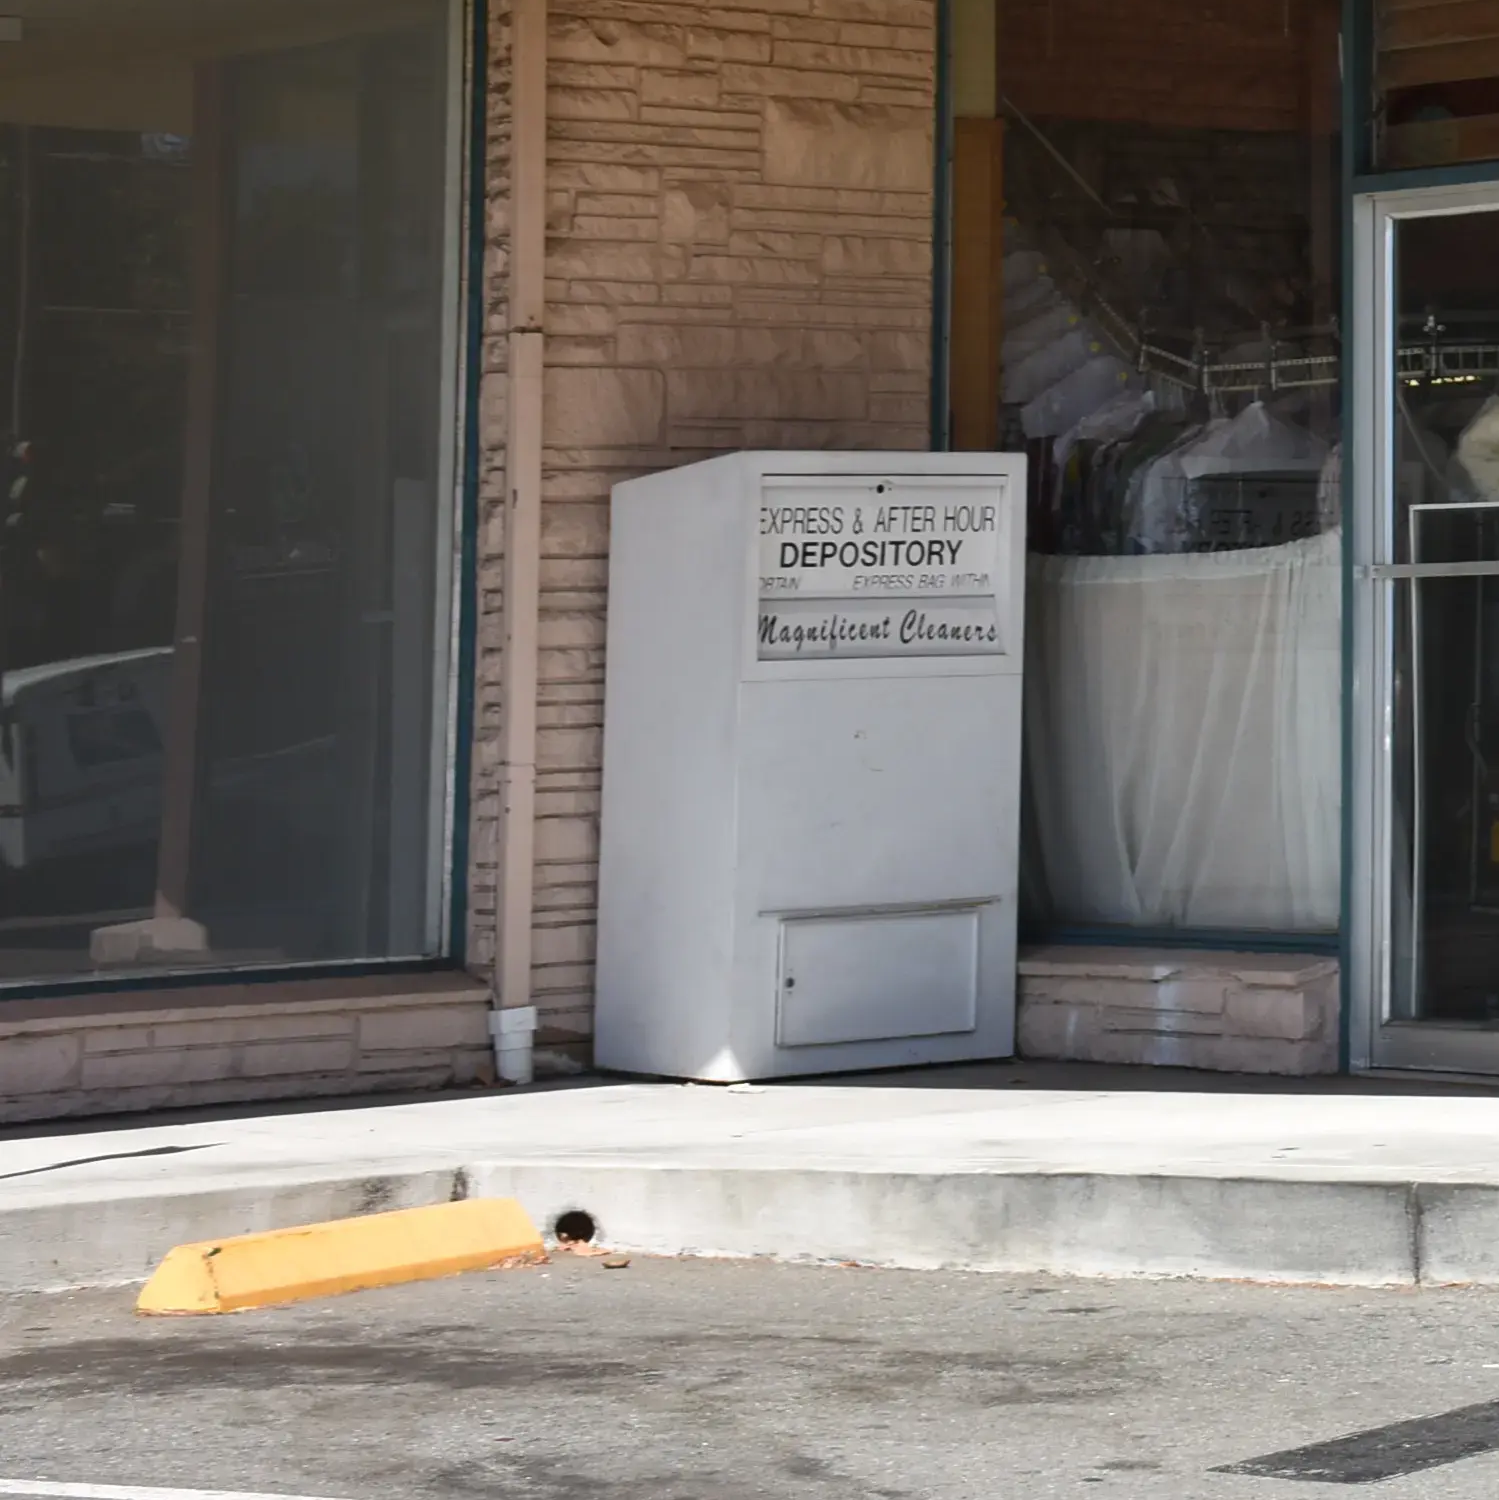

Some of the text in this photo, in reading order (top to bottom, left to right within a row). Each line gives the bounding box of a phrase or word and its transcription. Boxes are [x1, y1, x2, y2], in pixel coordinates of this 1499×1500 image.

[760, 505, 995, 534] EXPRESS & AFTER HOUR
[780, 540, 963, 568] DEPOSITORY
[852, 574, 914, 591] EXPRESS
[758, 609, 998, 650] Magnificent Cleaners
